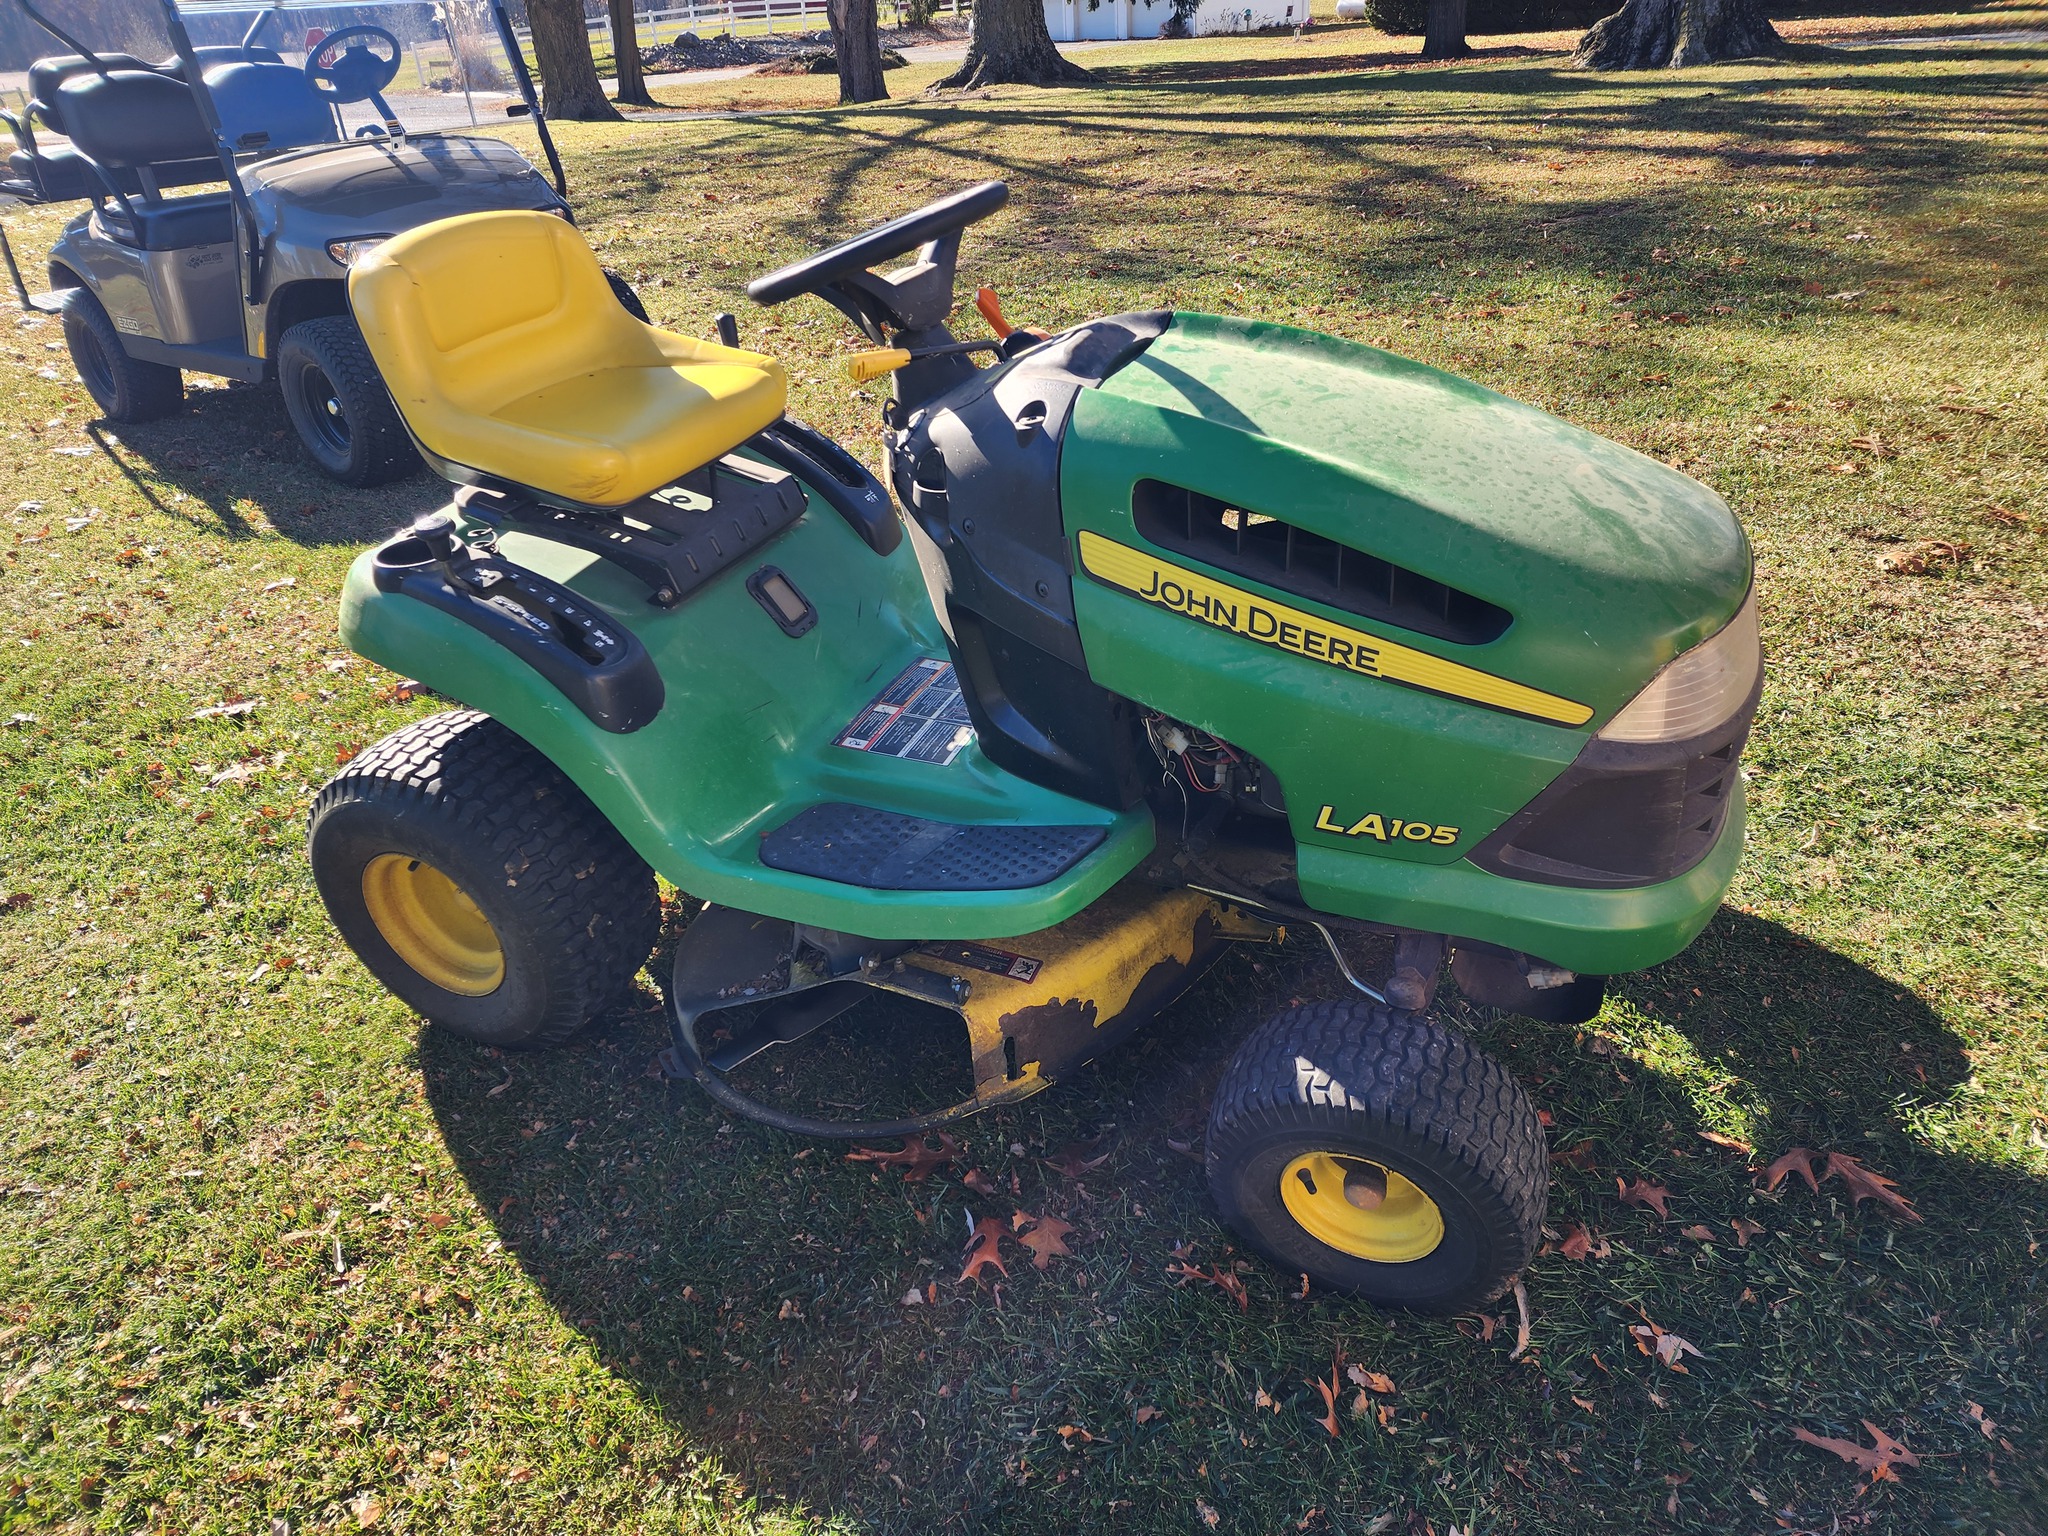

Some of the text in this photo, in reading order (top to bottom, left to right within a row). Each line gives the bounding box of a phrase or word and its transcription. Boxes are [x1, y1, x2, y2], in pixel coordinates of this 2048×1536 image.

[494, 596, 551, 630] 5-SPEED
[1140, 571, 1380, 673] JOHN DEERE
[1315, 805, 1460, 845] LA105
